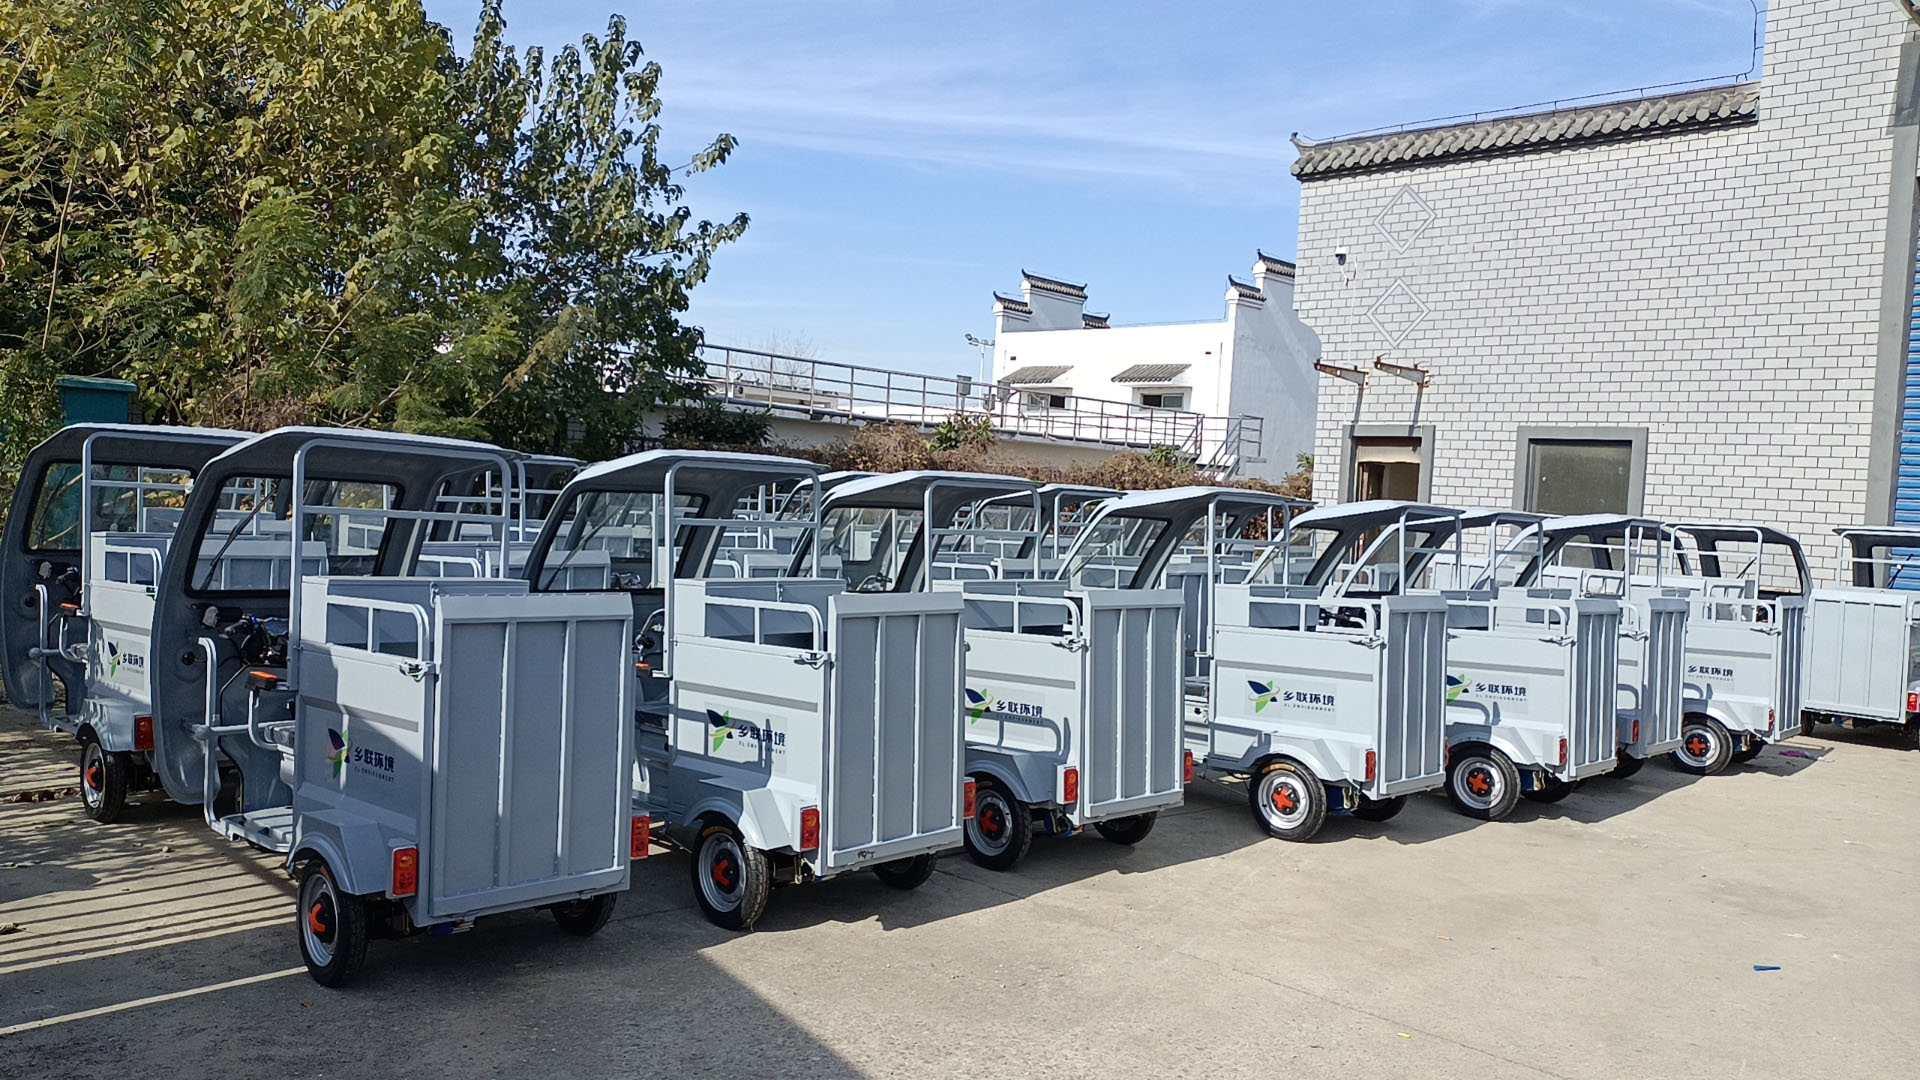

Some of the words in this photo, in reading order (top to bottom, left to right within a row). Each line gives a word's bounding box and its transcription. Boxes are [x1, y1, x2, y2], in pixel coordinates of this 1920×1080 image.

[1687, 665, 1734, 677] 乡联环境
[1475, 682, 1526, 696] 乡联环境
[1283, 690, 1335, 706] 乡联环境
[996, 699, 1042, 718] 乡联环境
[738, 724, 785, 746] 乡联环境
[354, 746, 394, 773] 乡联环境
